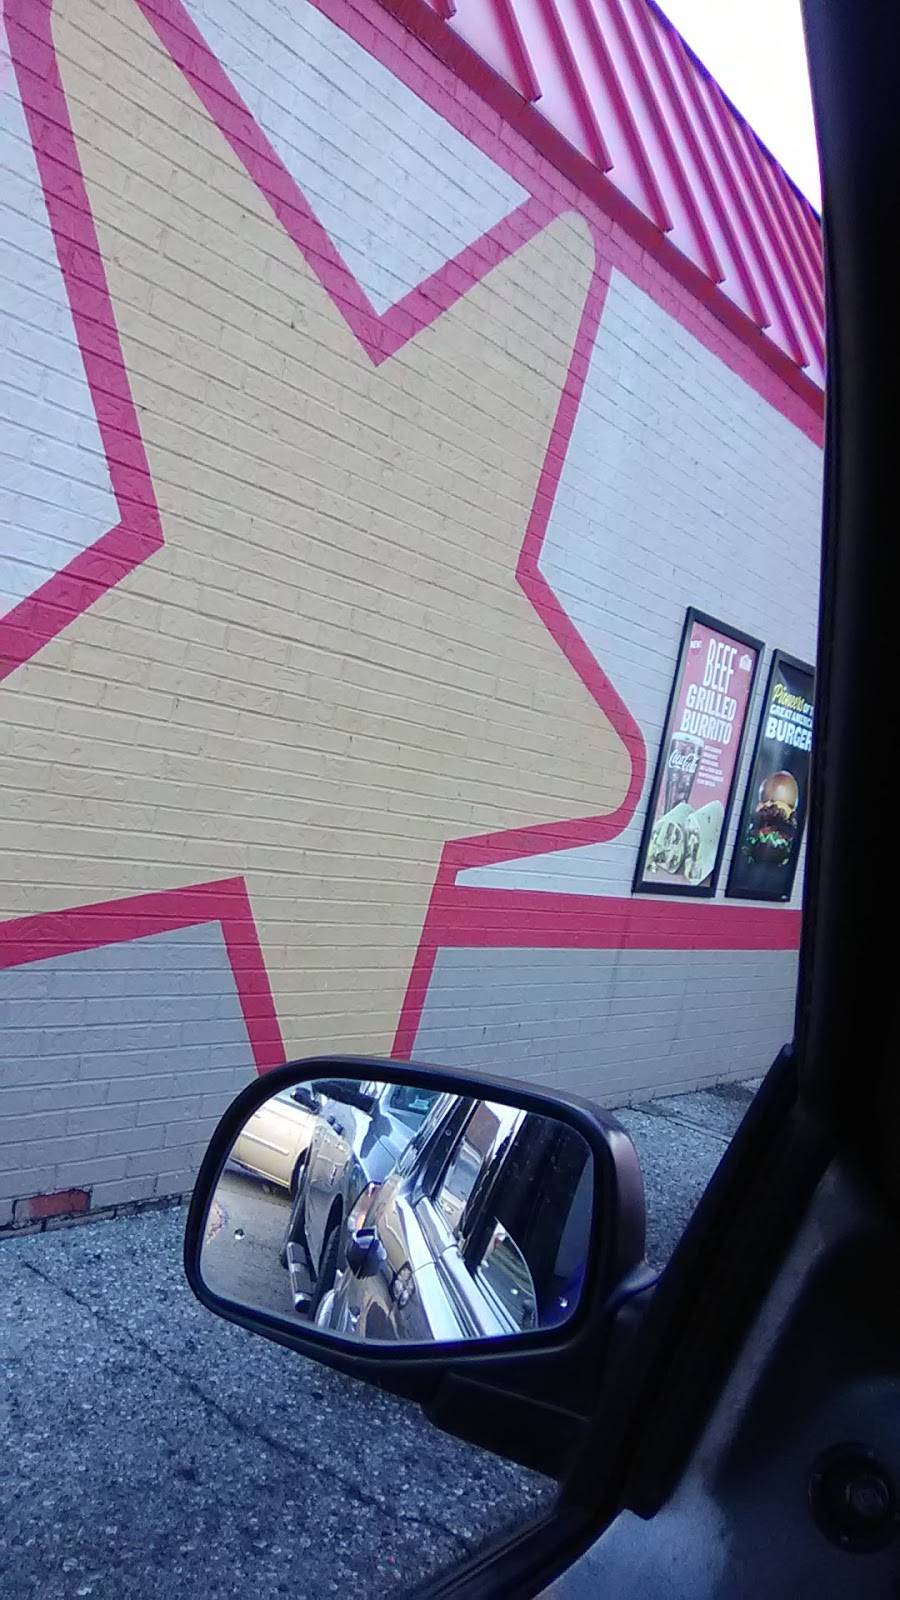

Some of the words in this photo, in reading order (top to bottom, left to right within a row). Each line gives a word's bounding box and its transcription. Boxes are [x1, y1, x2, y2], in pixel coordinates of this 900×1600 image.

[703, 638, 737, 694] BEEF
[686, 683, 737, 721] GRILLED
[680, 708, 733, 744] BURRITO
